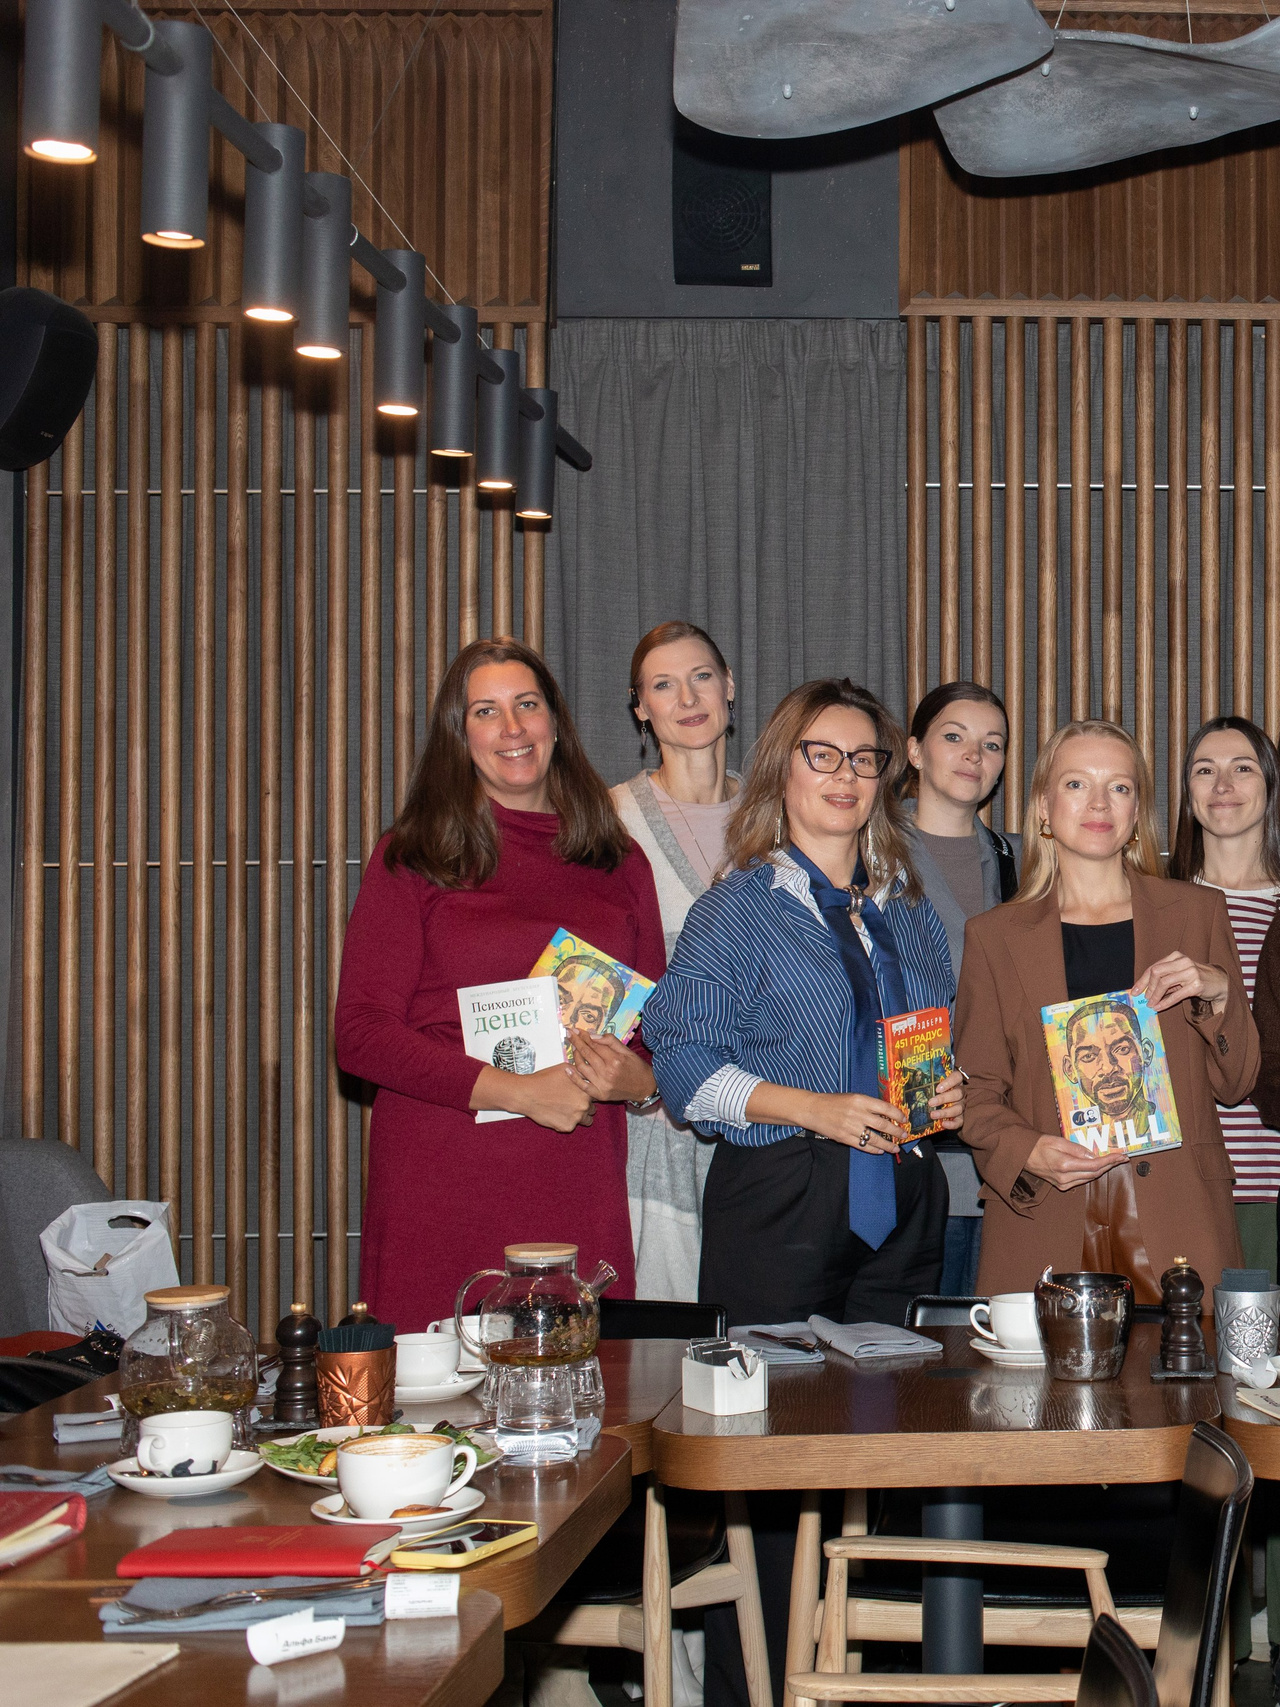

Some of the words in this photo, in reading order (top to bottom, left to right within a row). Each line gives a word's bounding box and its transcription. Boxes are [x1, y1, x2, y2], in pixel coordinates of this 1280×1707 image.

[471, 996, 538, 1013] Психологи
[894, 1038, 908, 1050] 451
[910, 1028, 943, 1046] ГРАДУС
[913, 1043, 926, 1055] ПО
[894, 1047, 945, 1070] ФАРЕНГЕЙТУ
[1073, 1114, 1171, 1153] WILL
